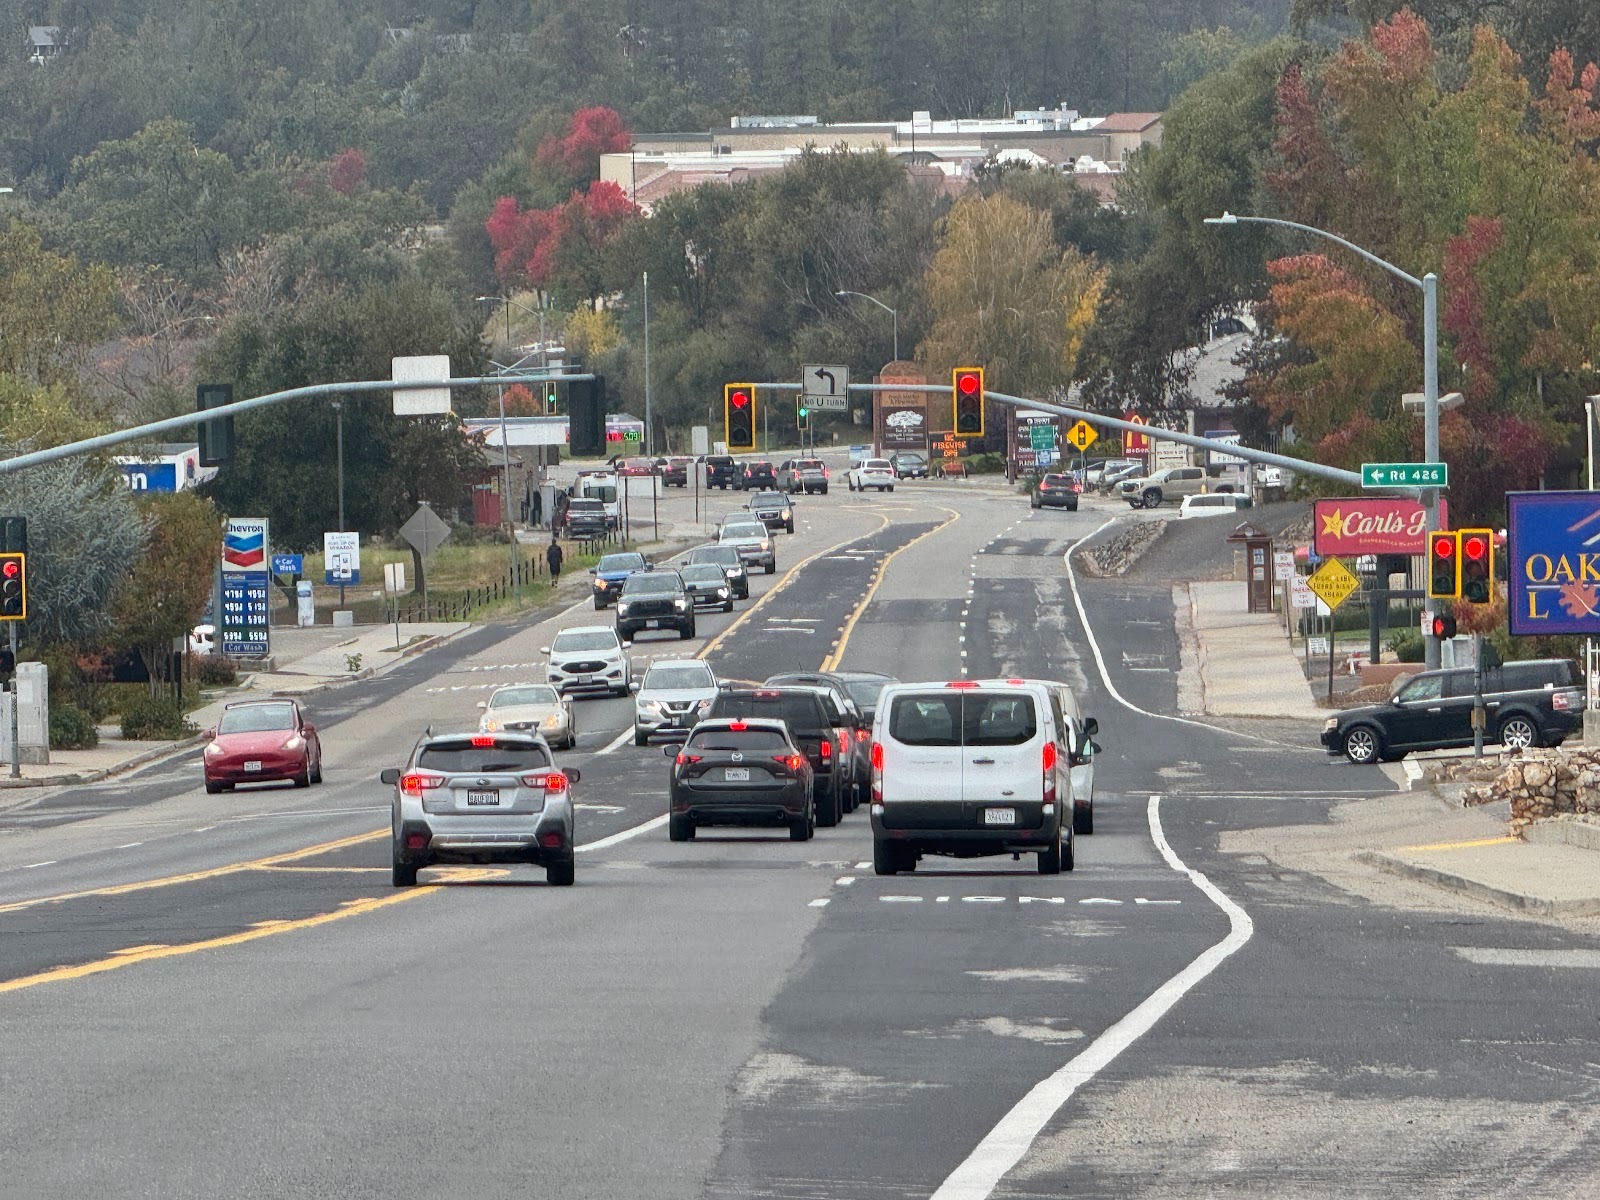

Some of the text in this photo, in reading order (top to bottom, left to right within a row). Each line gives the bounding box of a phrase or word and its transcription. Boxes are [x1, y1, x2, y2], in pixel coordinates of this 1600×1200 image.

[817, 397, 824, 407] U
[827, 399, 845, 407] TURN
[1390, 470, 1439, 480] Rd 426
[1341, 510, 1426, 537] Carl's J
[1525, 553, 1600, 583] OAK
